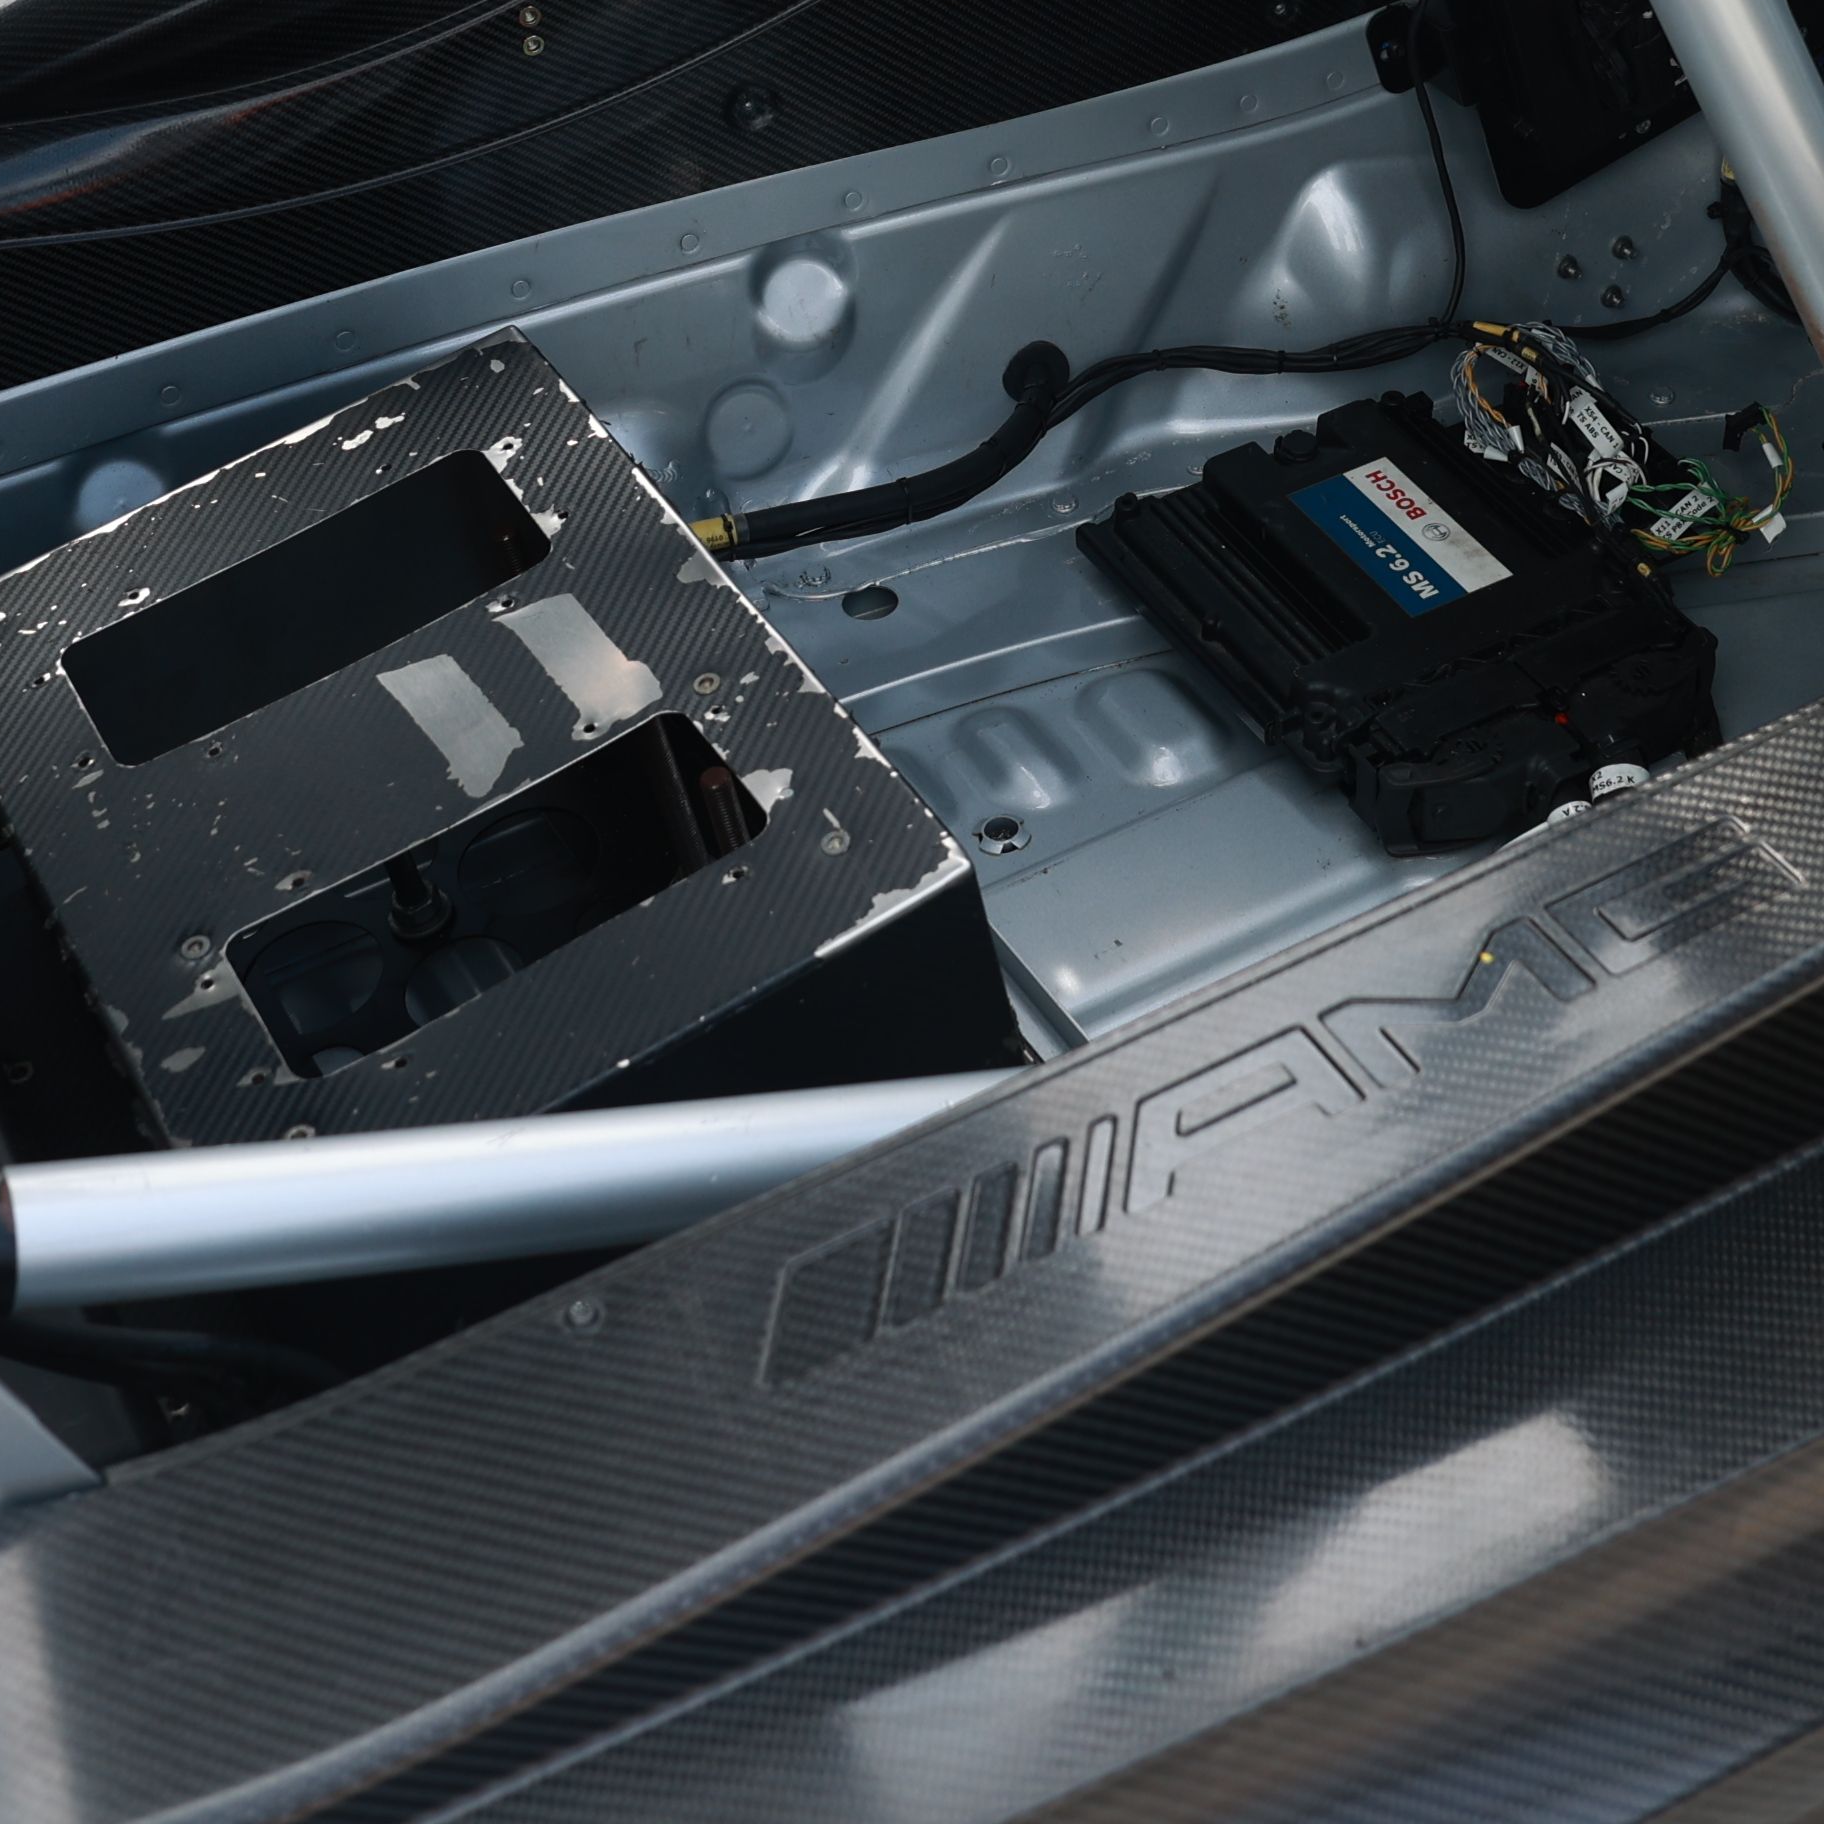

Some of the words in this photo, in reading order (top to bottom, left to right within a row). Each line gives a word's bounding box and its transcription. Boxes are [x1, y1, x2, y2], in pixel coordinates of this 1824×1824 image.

[1576, 412, 1587, 424] TS
[1585, 424, 1599, 439] ABS
[1583, 405, 1599, 423] X54
[1600, 426, 1614, 444] CAN
[1365, 470, 1427, 520] BOSCH
[1339, 514, 1377, 548] Motorsport
[1375, 544, 1411, 572] 6.2
[1402, 571, 1440, 600] MS
[1627, 776, 1636, 784] K
